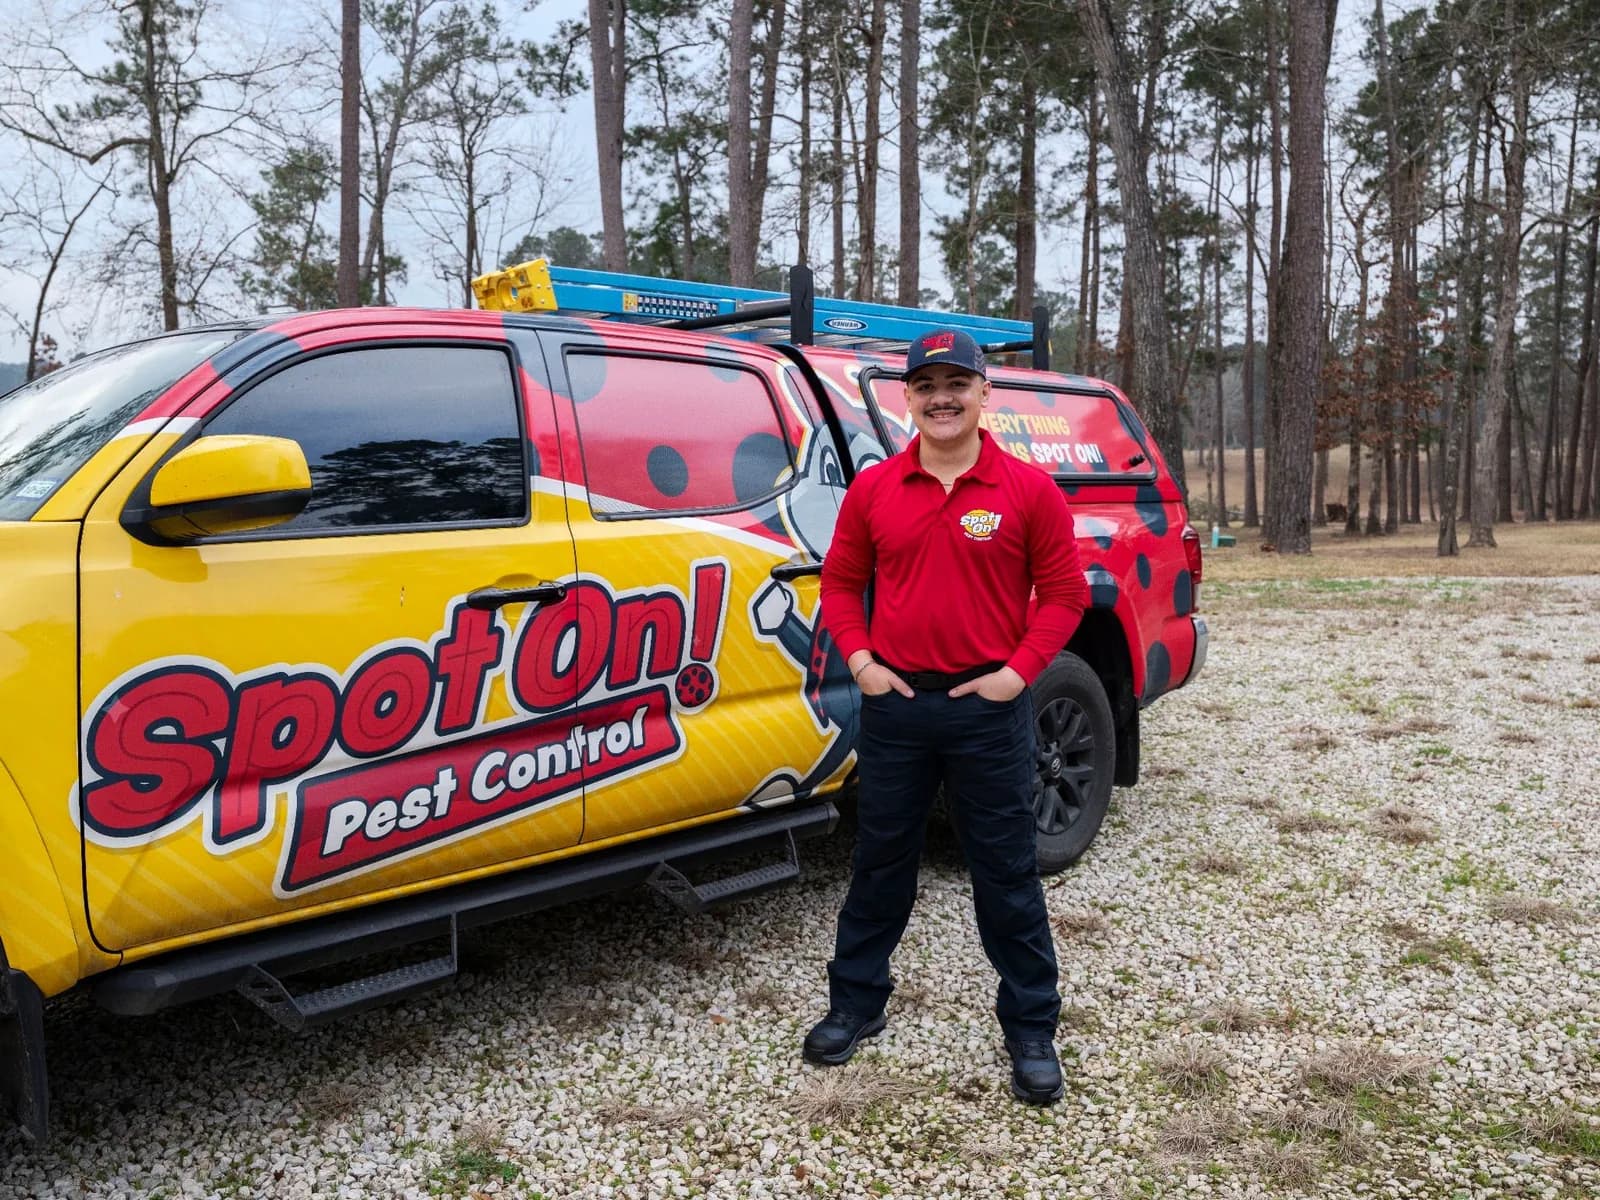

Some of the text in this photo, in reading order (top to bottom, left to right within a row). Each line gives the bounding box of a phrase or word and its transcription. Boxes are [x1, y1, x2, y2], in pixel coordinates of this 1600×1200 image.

[978, 412, 1071, 435] VERYTHING
[1030, 442, 1072, 464] SPOT
[1075, 443, 1104, 463] ON!
[80, 562, 727, 846] Spot On!
[322, 706, 646, 856] Pest Control
